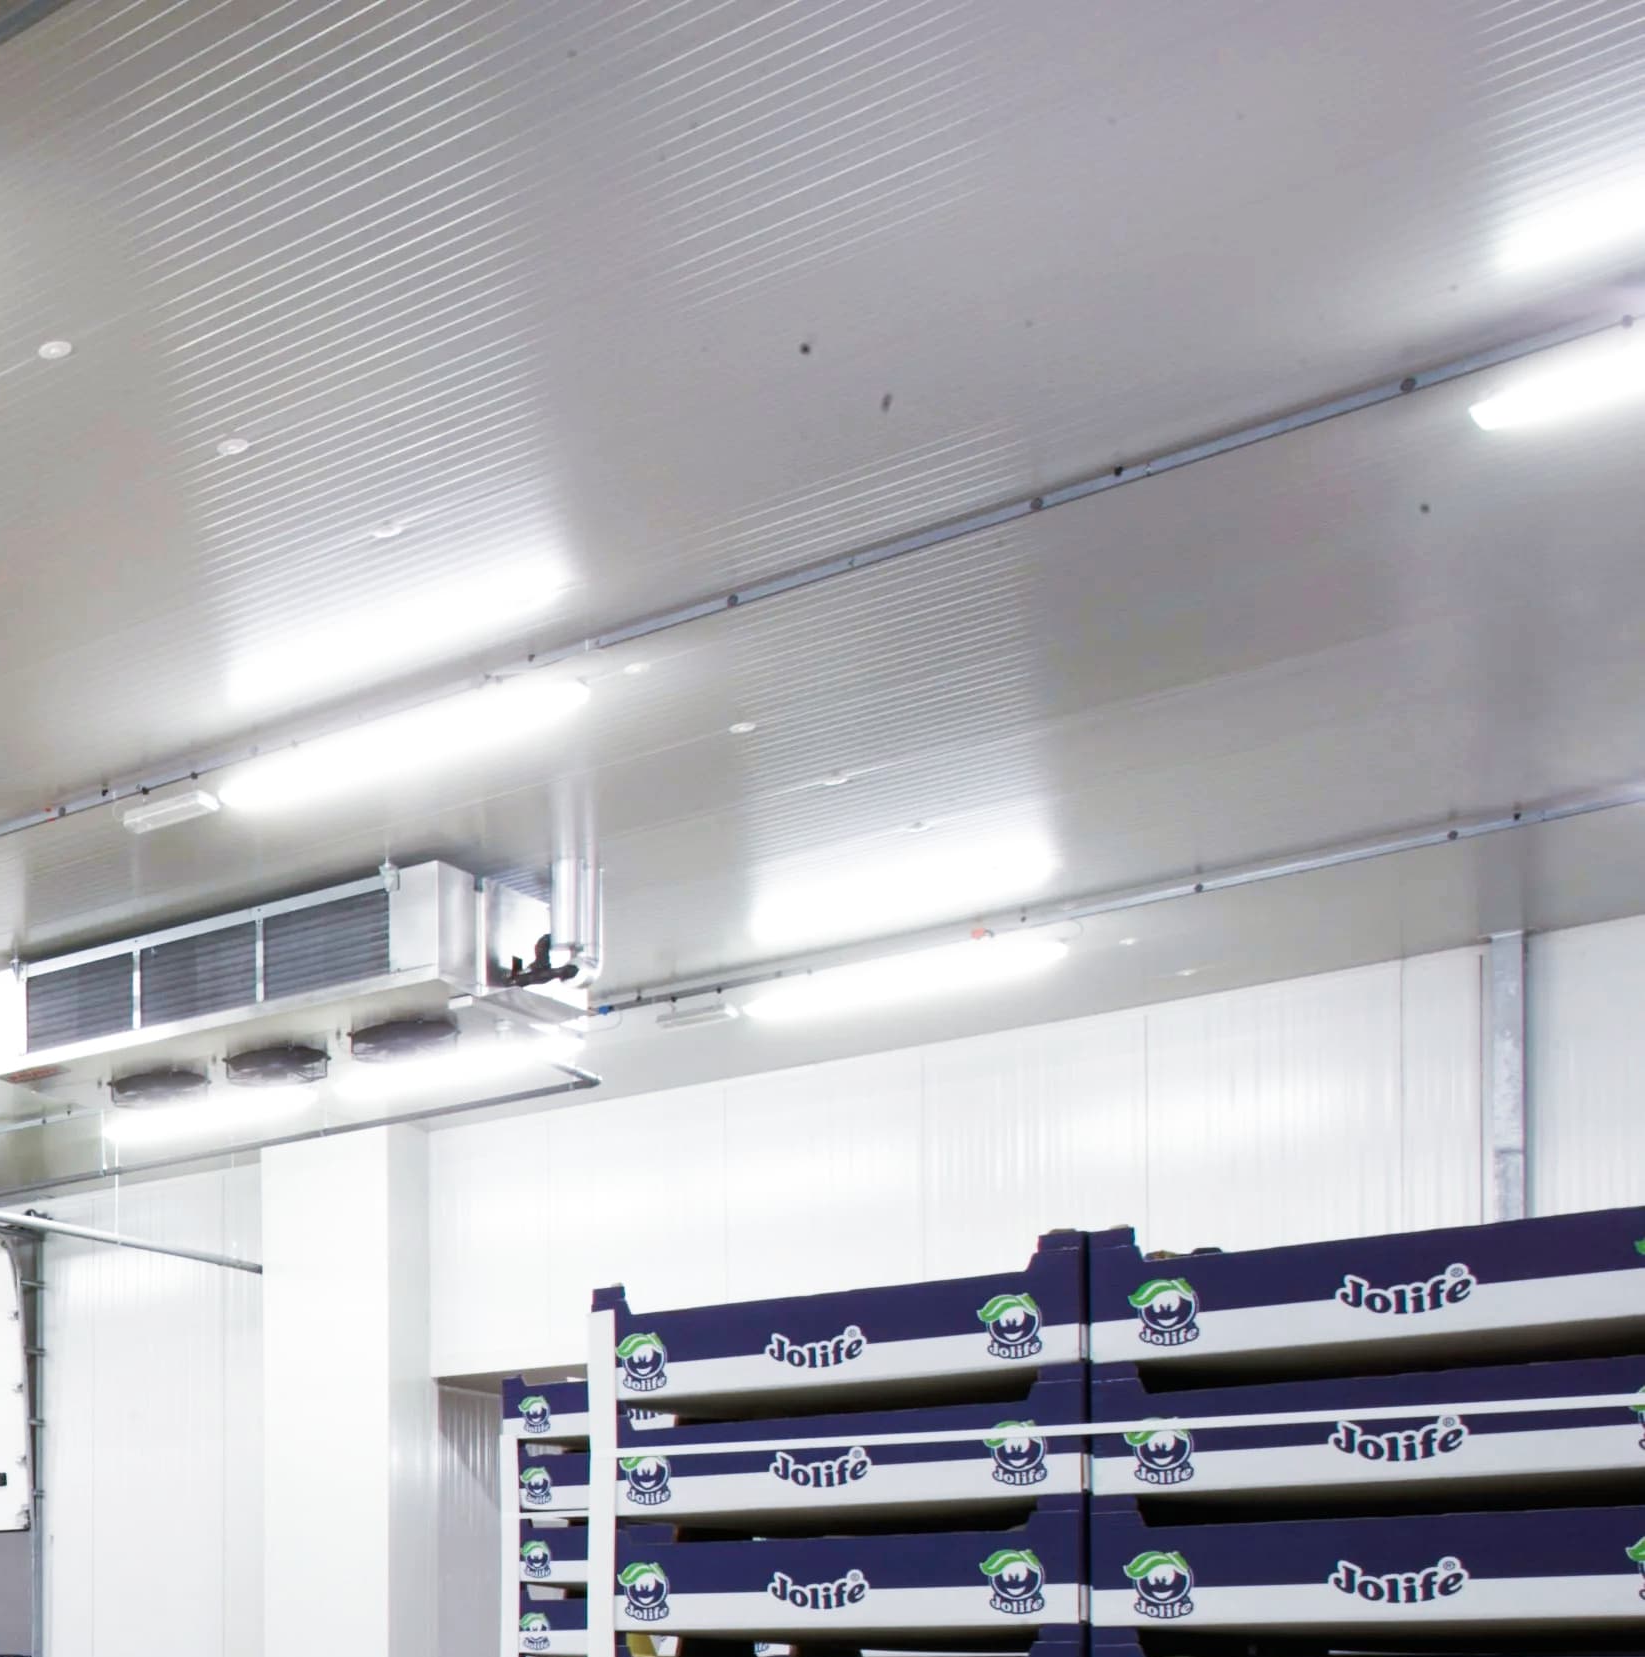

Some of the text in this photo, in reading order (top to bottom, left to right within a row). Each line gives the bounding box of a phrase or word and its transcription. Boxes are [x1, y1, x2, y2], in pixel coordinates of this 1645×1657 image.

[1339, 1277, 1471, 1313] Jolife
[1139, 1327, 1199, 1346] Jolife
[769, 1336, 862, 1368] Jolife
[988, 1341, 1041, 1357] Jolife
[624, 1376, 665, 1389] Jolife
[1333, 1422, 1465, 1462] Jolife
[774, 1454, 867, 1487] Jolife
[992, 1467, 1047, 1485] Jolife
[1135, 1466, 1194, 1485] Jolife
[628, 1490, 670, 1504] Jolife
[772, 1575, 865, 1608] Jolife
[1333, 1565, 1465, 1603] Jolife
[626, 1605, 668, 1620] Jolife
[990, 1596, 1044, 1614] Jolife
[1134, 1599, 1193, 1619] Jolife
